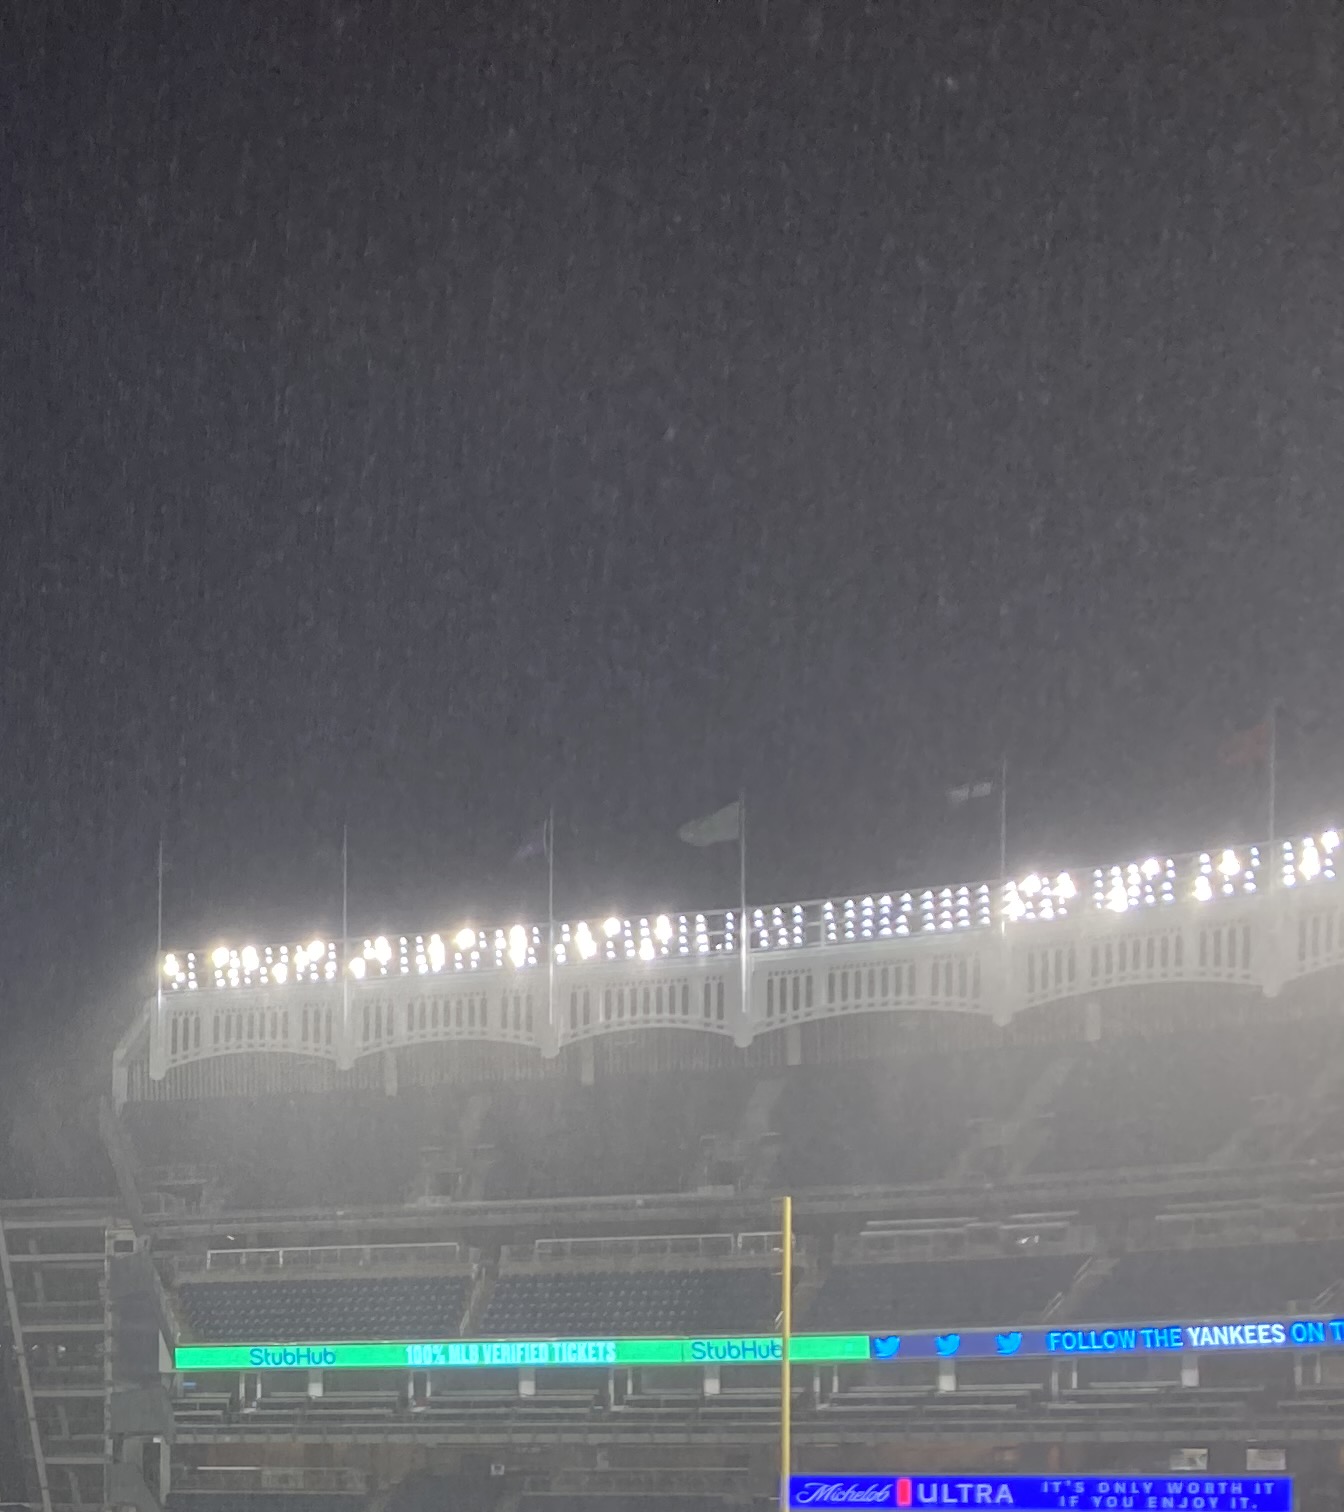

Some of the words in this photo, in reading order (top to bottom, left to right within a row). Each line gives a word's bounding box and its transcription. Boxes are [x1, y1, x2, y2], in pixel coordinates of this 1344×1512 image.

[1047, 1331, 1137, 1352] FOLLOW
[1140, 1328, 1184, 1349] THE
[1186, 1324, 1285, 1347] YANKEES
[1290, 1322, 1325, 1342] ON
[249, 1348, 336, 1365] StubHub
[481, 1344, 548, 1363] VERIFIED
[550, 1342, 616, 1362] TICKETS
[690, 1340, 781, 1360] StubHub
[797, 1482, 894, 1503] Michelob
[918, 1483, 1013, 1503] ULTRA
[1043, 1480, 1085, 1494] IT'S
[1099, 1481, 1154, 1495] ONLY
[1168, 1482, 1242, 1495] WORTH
[1256, 1482, 1274, 1495] IT
[1059, 1497, 1078, 1508] IF
[1091, 1497, 1134, 1509] YOU
[1149, 1498, 1219, 1509] ENJOY
[1231, 1498, 1258, 1509] IT.
